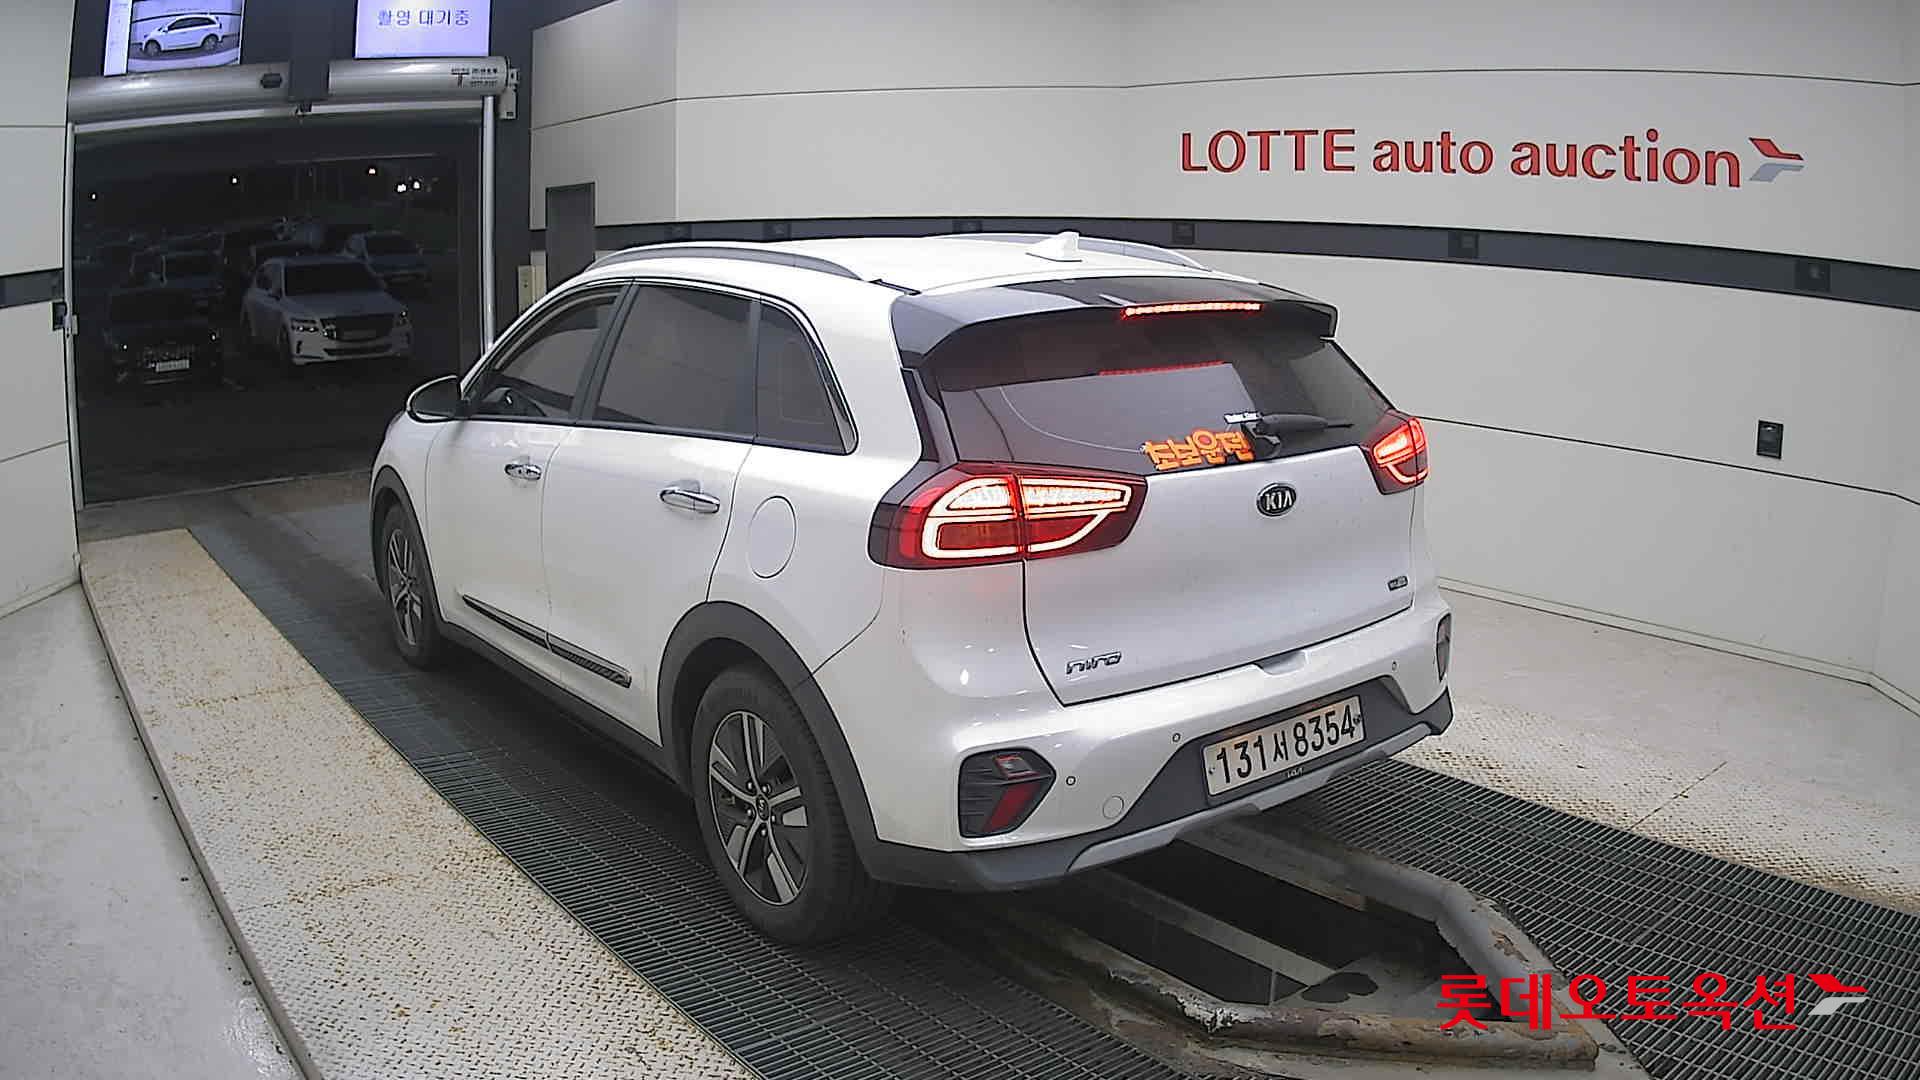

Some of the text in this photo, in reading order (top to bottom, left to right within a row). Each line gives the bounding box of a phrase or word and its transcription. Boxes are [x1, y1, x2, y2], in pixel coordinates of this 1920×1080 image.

[1180, 128, 1742, 188] LOTTE auto auction
[1263, 488, 1294, 512] KIA
